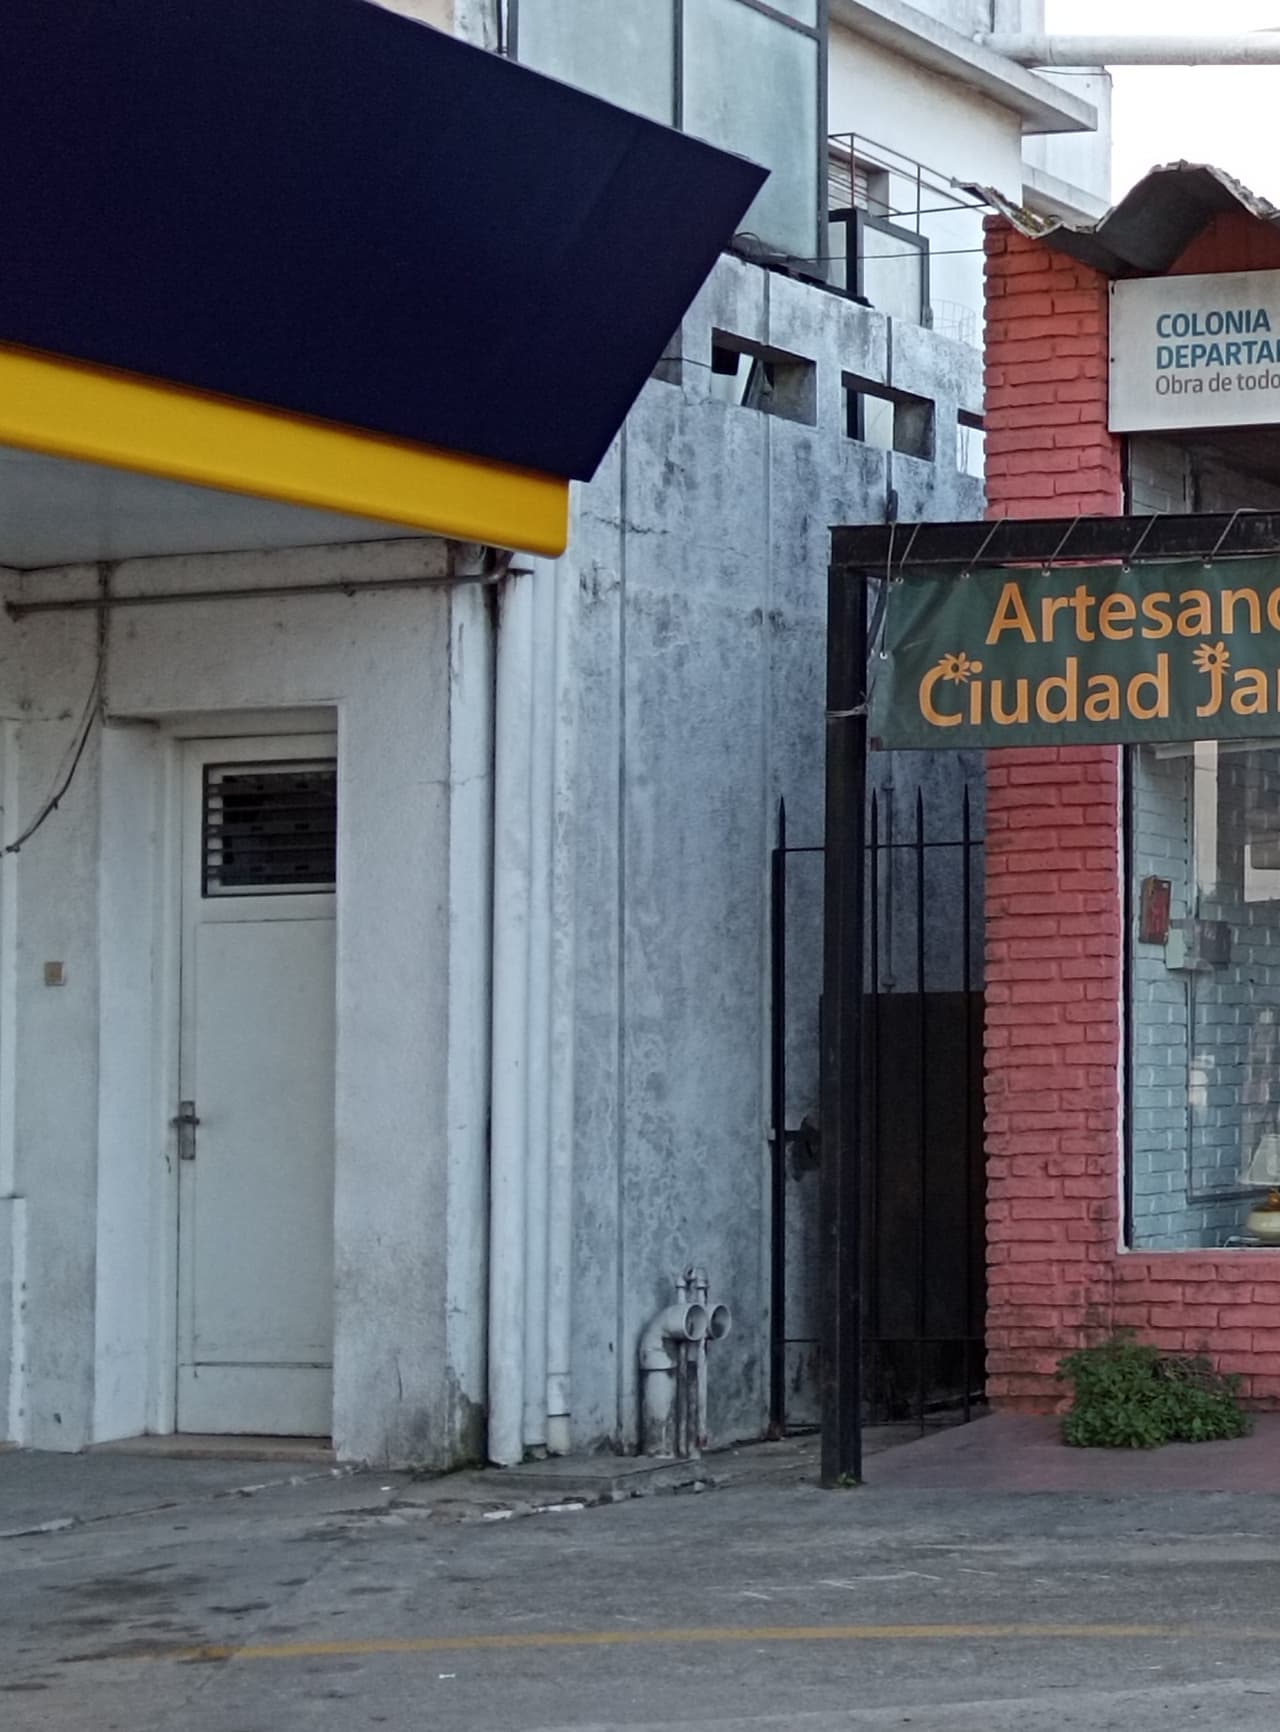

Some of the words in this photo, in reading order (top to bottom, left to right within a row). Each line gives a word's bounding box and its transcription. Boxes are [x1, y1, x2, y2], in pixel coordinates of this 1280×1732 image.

[1155, 308, 1271, 339] COLONIA
[1155, 371, 1203, 395] Obra
[1208, 371, 1233, 393] de
[918, 652, 1169, 727] Ciudad
